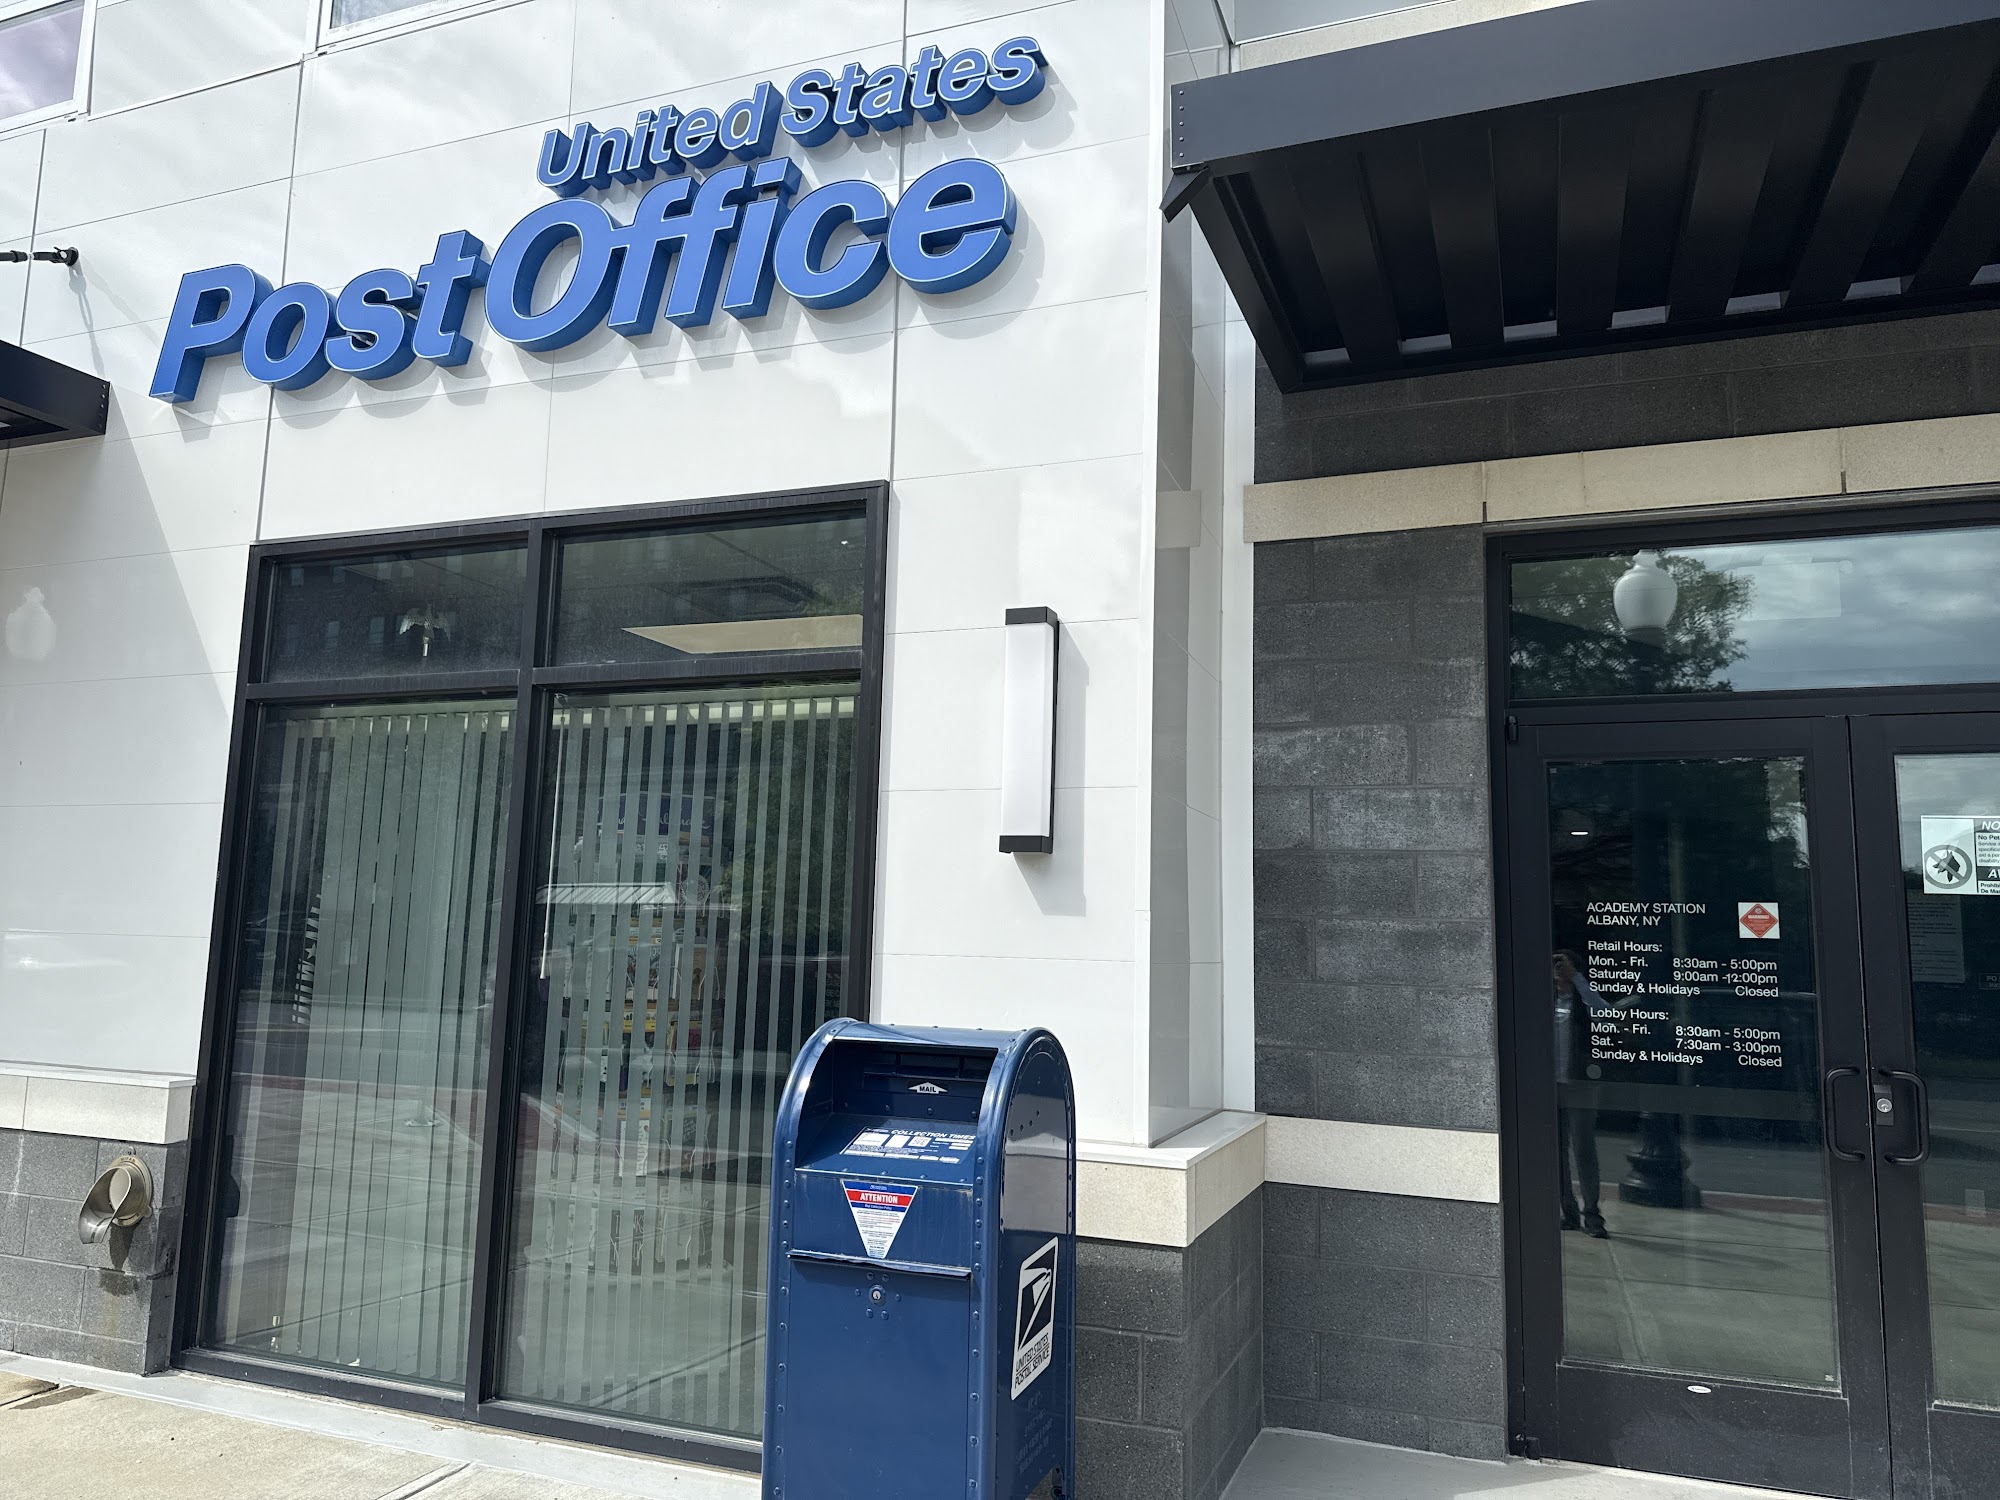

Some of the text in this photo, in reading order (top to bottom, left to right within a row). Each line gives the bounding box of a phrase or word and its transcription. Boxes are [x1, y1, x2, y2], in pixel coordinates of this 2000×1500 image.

[538, 37, 1047, 192] United States
[149, 158, 1018, 402] Post Office
[1586, 902, 1706, 914] ACADEMY STATION
[1587, 915, 1661, 927] ALBANY, NY
[1588, 941, 1663, 952] Retail Hours:
[1588, 955, 1618, 966] Mon.
[1630, 957, 1648, 967] Fri.
[1673, 958, 1718, 969] 8:30am
[1730, 959, 1777, 972] 5:00pm
[1589, 969, 1641, 981] Saturday
[1673, 971, 1718, 982] 9:00am
[1589, 982, 1779, 997] Sunday & Holidays Closed
[1590, 1007, 1669, 1021] Lobby Hours:
[1591, 1023, 1620, 1033] Mon.
[1632, 1024, 1651, 1035] Fri.
[1675, 1026, 1721, 1037] 8:30am
[1733, 1028, 1780, 1041] 5:00pm
[1591, 1035, 1614, 1046] Sat.
[1675, 1039, 1721, 1051] 7:30am
[1733, 1041, 1781, 1054] 3:00pm
[1591, 1048, 1782, 1067] Sunday & Holidays Closed
[919, 1085, 937, 1093] MAIL
[891, 1129, 948, 1138] COLLECTION
[860, 1192, 898, 1204] ATTENTION
[1015, 1332, 1049, 1372] UNITED STATES
[1014, 1345, 1050, 1390] POSTAL SERVICE
